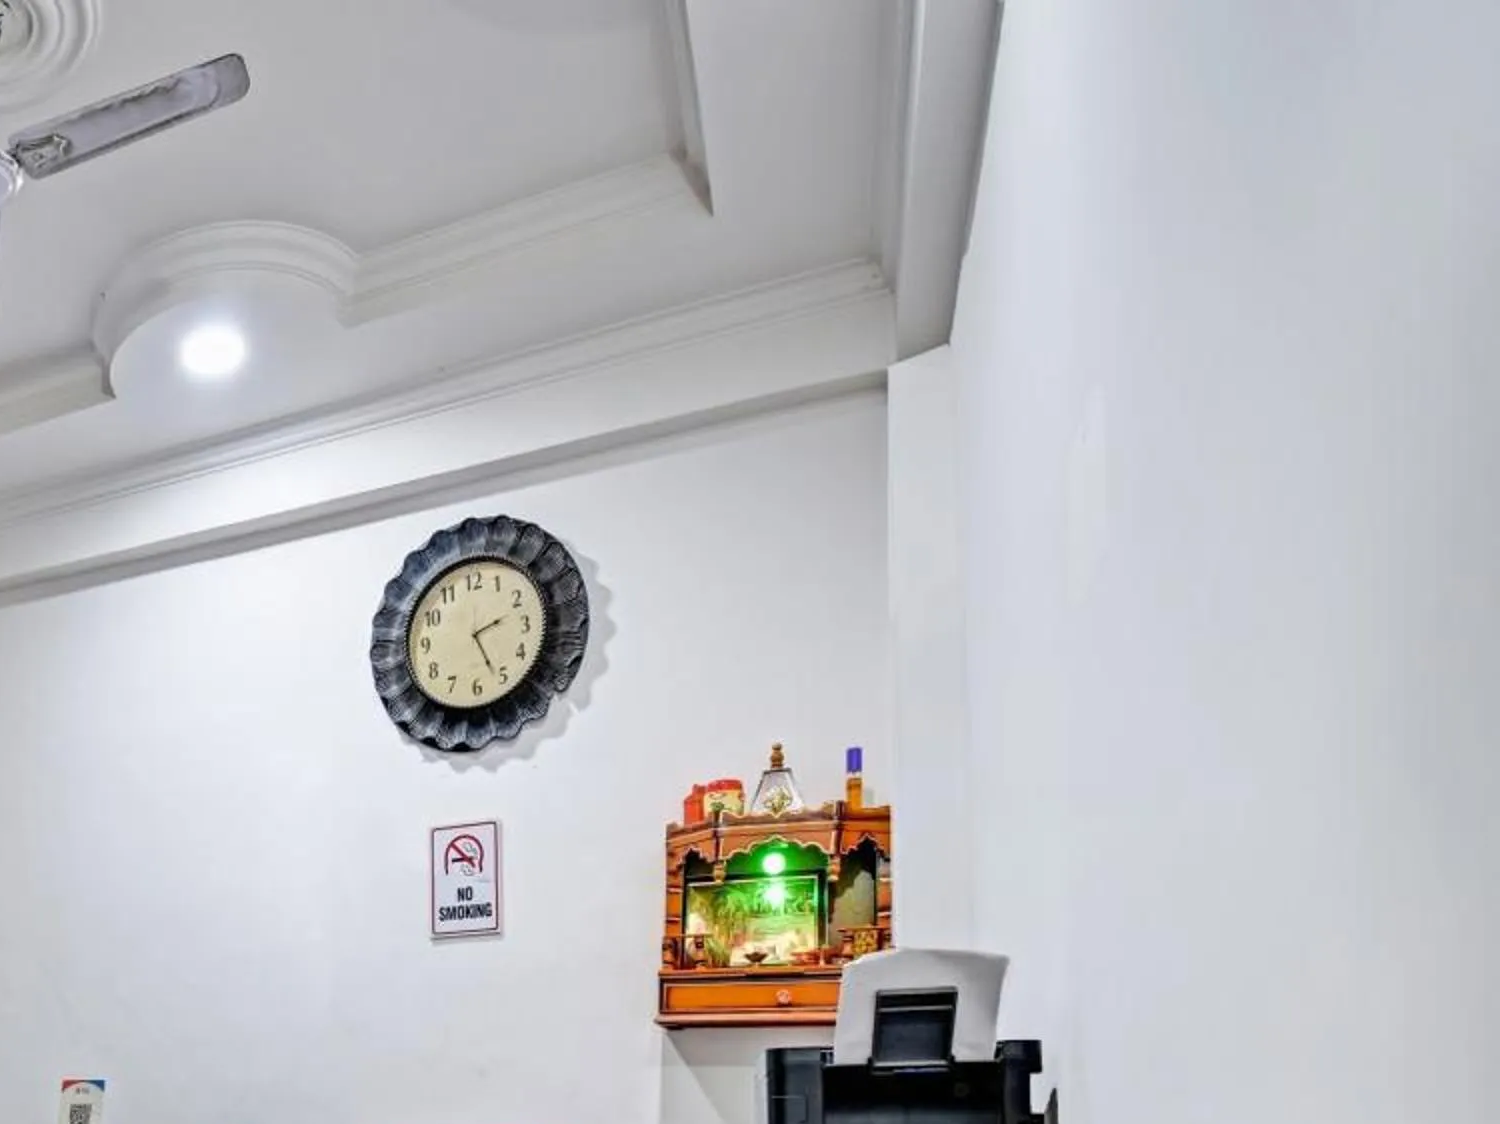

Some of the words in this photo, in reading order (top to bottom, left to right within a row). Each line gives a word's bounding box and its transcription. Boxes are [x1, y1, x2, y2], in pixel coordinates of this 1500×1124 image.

[466, 572, 483, 591] 12
[494, 575, 501, 592] 1
[440, 586, 456, 604] 11
[512, 589, 522, 608] 2
[424, 608, 441, 627] 10
[520, 615, 531, 634] 3
[421, 637, 431, 654] 9
[516, 642, 526, 660] 4
[429, 662, 439, 679] 8
[499, 667, 508, 685] 5
[447, 675, 457, 693] 7
[472, 678, 483, 696] 6
[457, 886, 473, 902] NO
[439, 902, 493, 921] SMOKING
